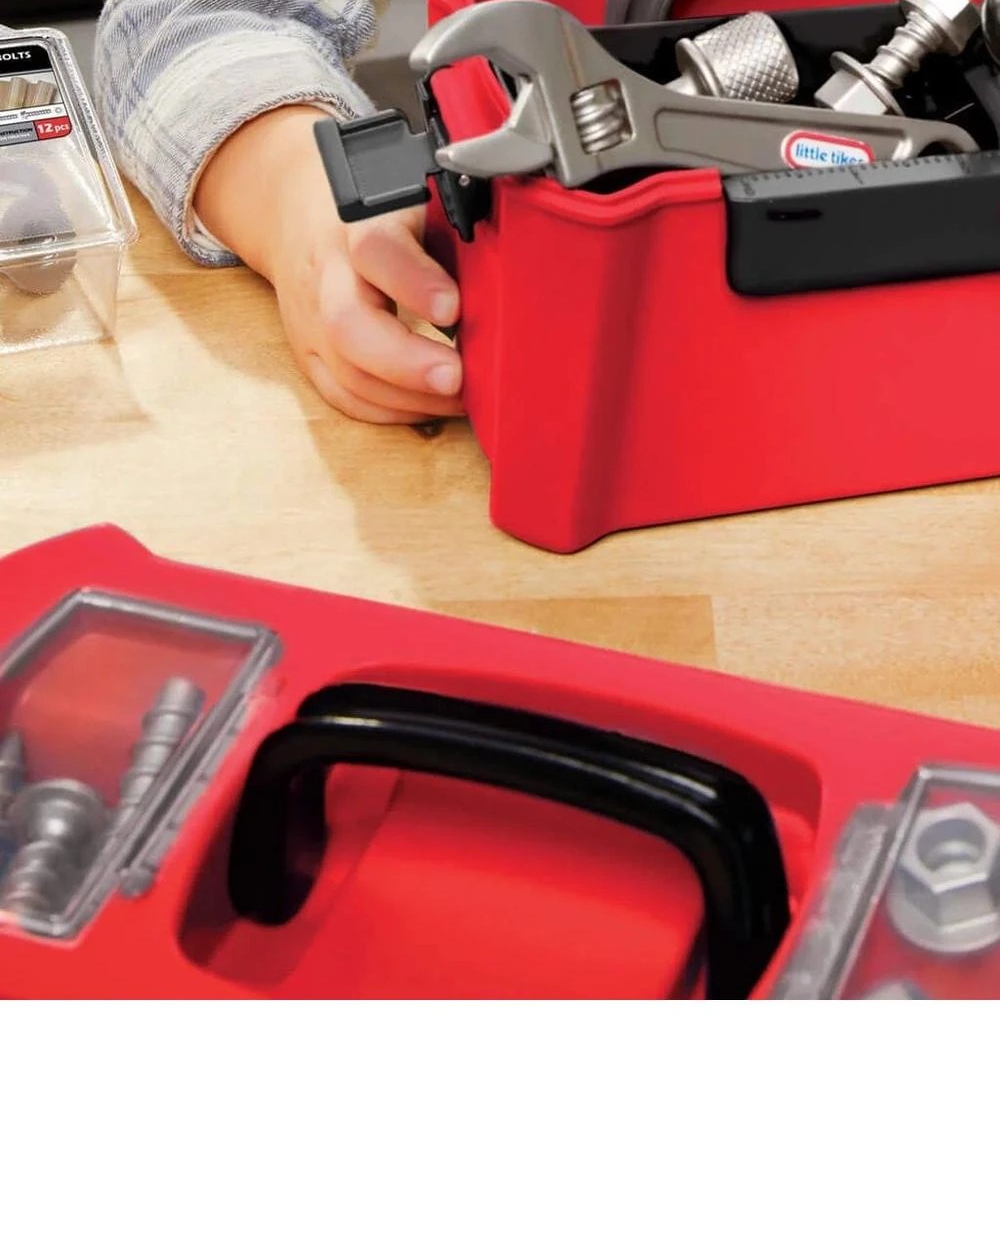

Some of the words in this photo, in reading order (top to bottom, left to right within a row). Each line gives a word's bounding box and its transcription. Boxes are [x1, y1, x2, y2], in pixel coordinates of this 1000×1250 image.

[0, 50, 31, 61] OLTS
[37, 123, 54, 135] 12
[54, 123, 70, 134] pcs
[795, 143, 829, 163] little
